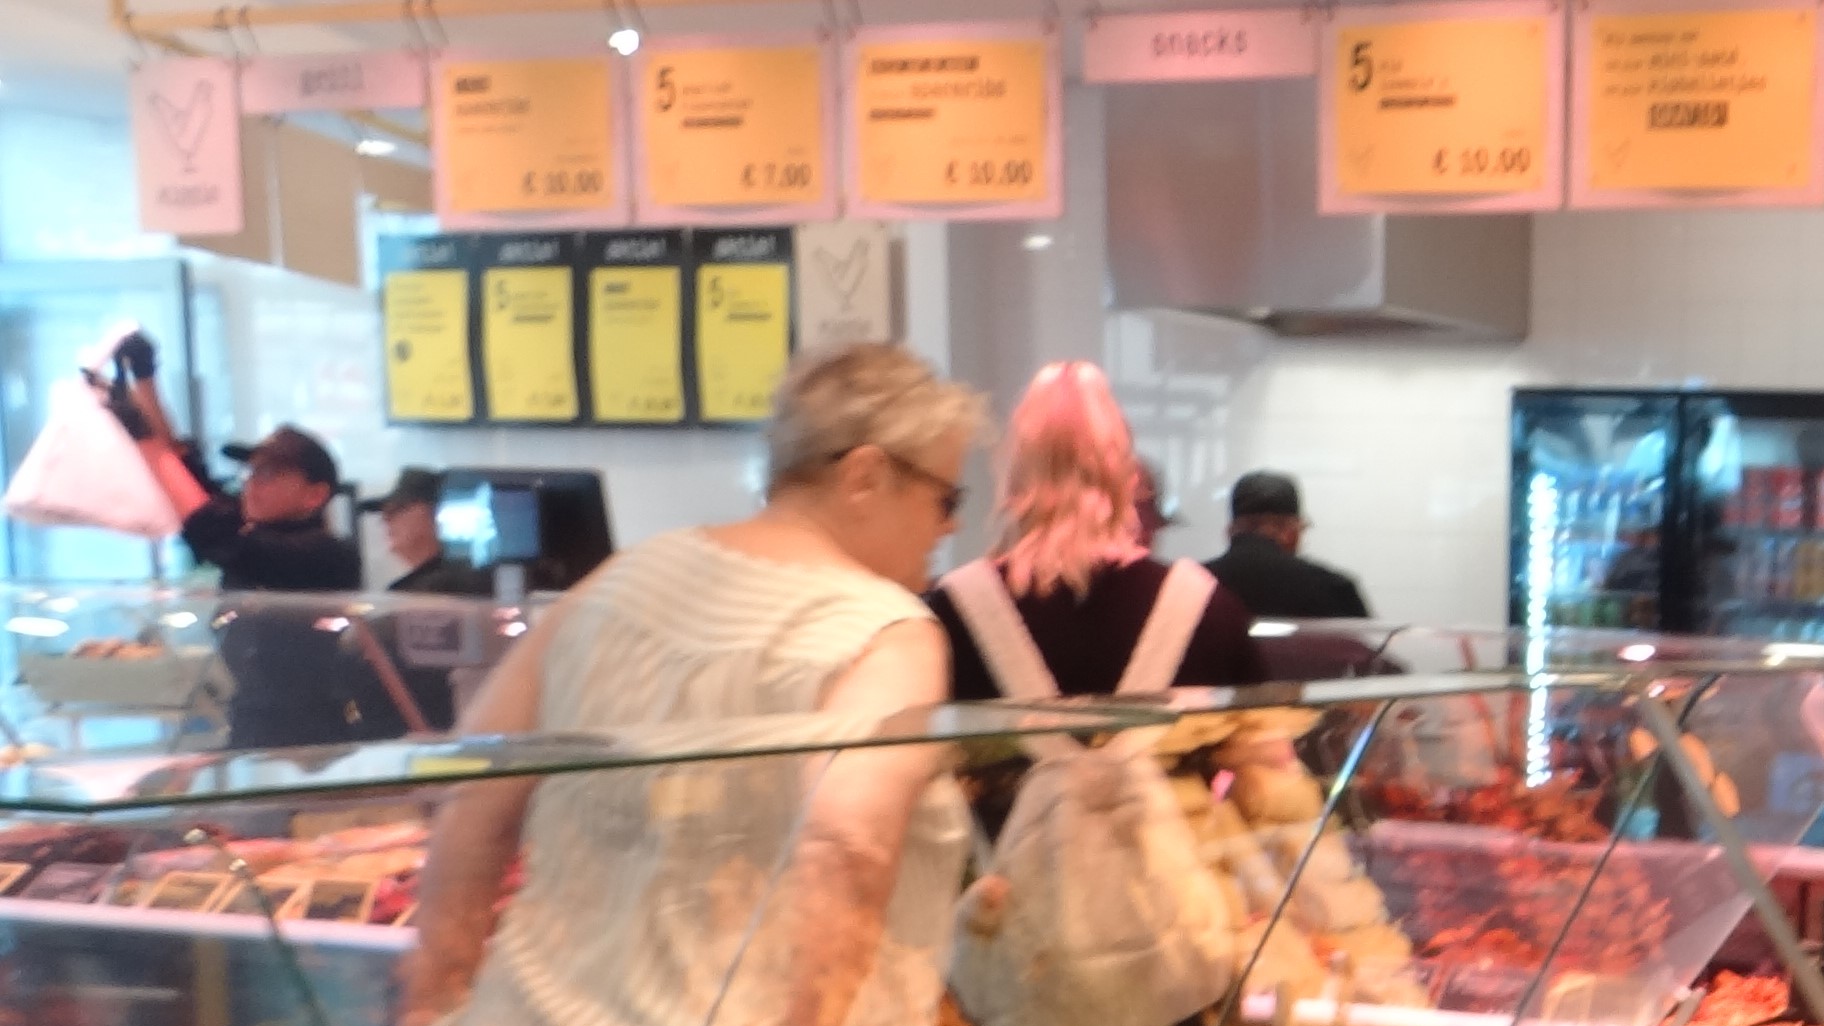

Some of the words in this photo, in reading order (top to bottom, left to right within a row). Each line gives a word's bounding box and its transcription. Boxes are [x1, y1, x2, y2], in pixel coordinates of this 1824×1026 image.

[1151, 26, 1249, 59] snacks
[1348, 40, 1375, 93] 5
[656, 66, 677, 113] 5
[741, 162, 757, 189] €
[945, 160, 960, 185] €
[1433, 147, 1450, 176] €
